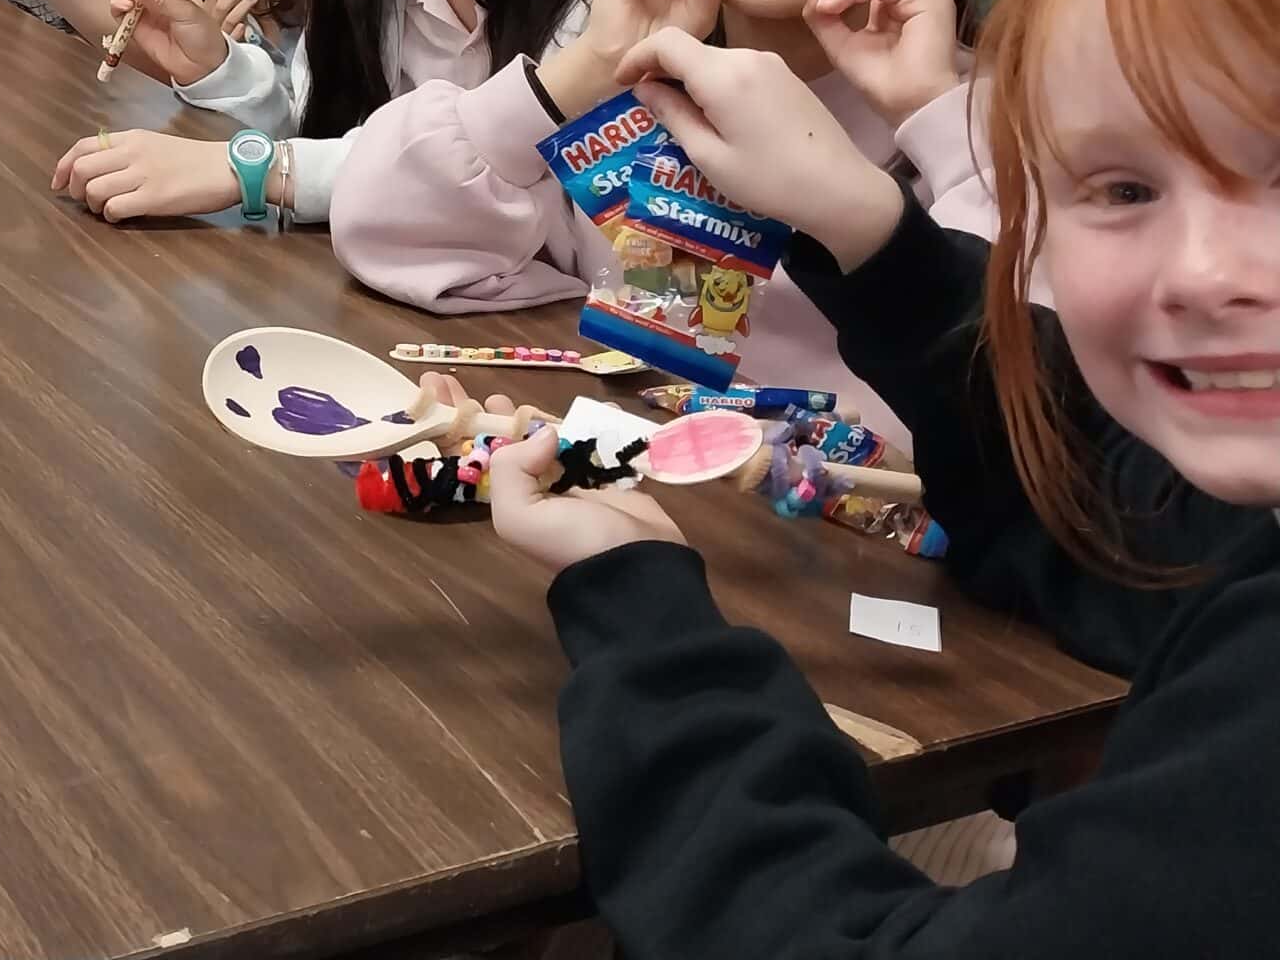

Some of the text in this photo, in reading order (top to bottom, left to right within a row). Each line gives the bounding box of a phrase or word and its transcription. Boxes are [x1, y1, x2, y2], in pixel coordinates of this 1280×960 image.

[562, 106, 657, 173] HARIB
[592, 166, 633, 196] Sta
[649, 196, 756, 248] Starmix
[699, 396, 755, 408] HARIBO
